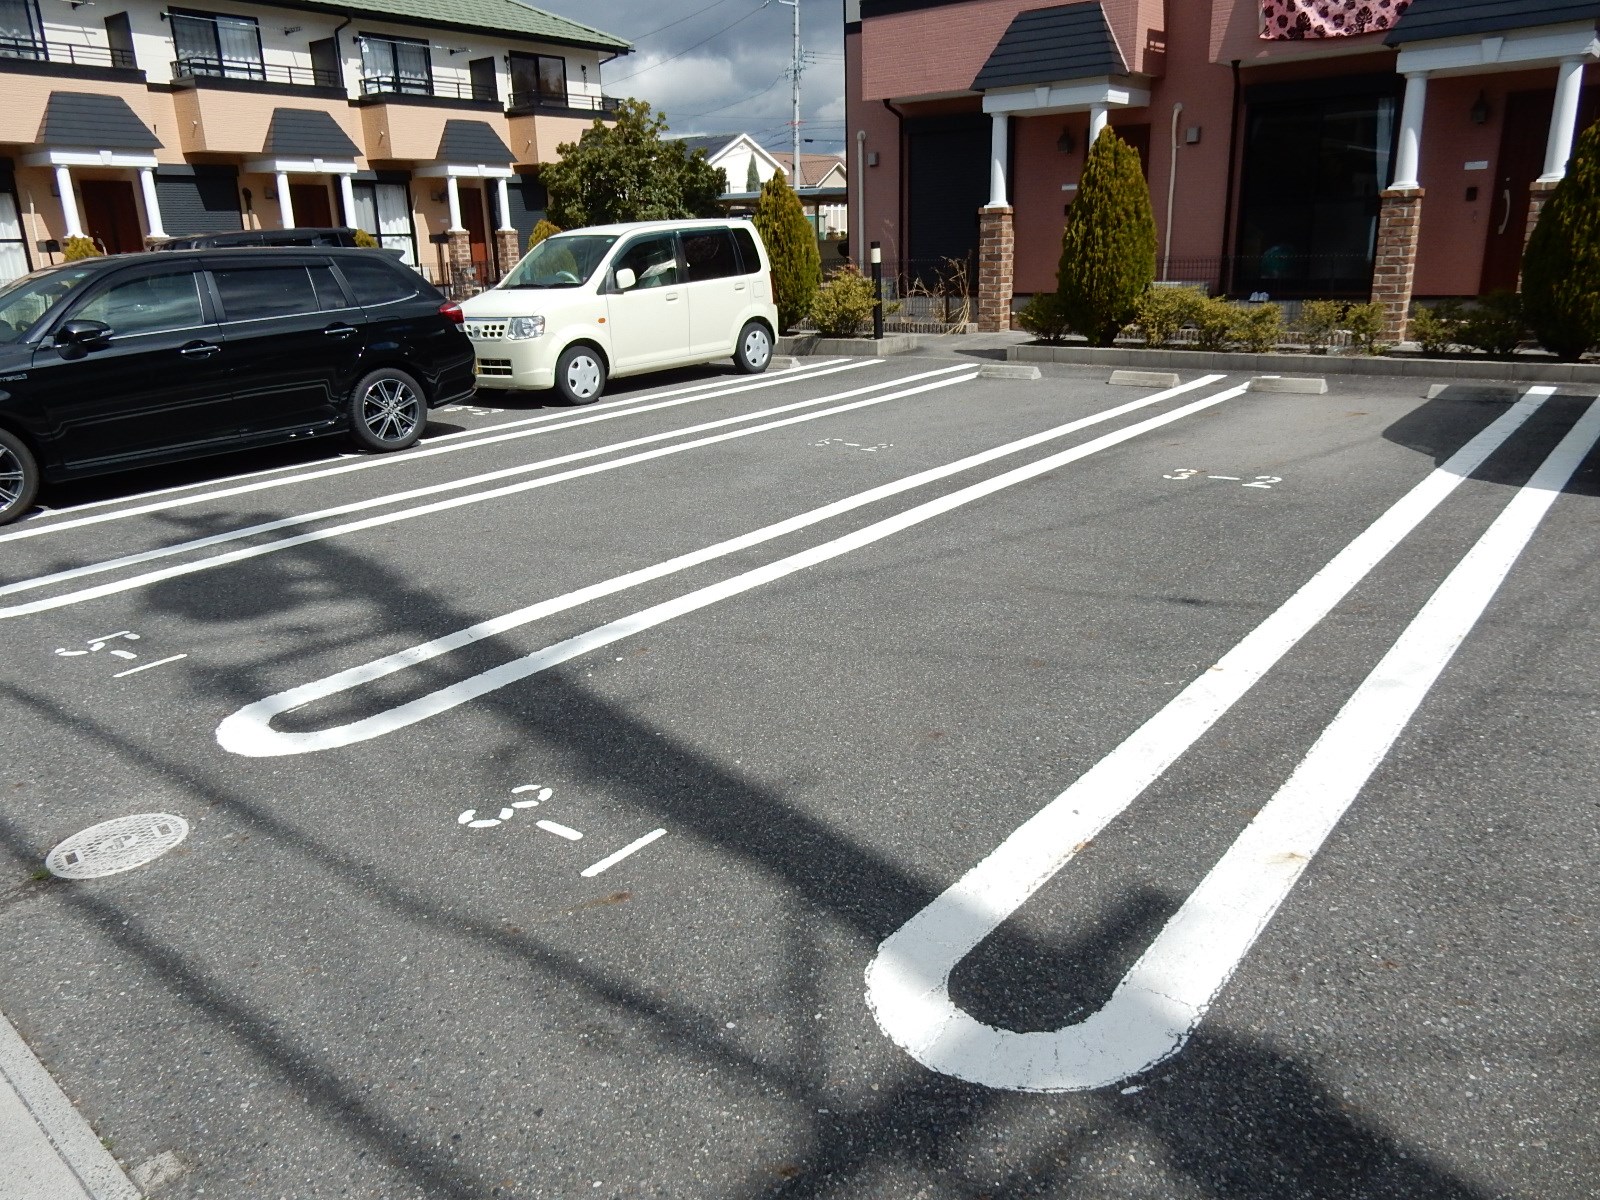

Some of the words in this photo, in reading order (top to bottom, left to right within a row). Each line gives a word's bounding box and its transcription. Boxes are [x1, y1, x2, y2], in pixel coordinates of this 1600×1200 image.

[1162, 468, 1282, 488] 3-2
[54, 630, 188, 678] 5-1
[457, 784, 668, 877] 3-1
